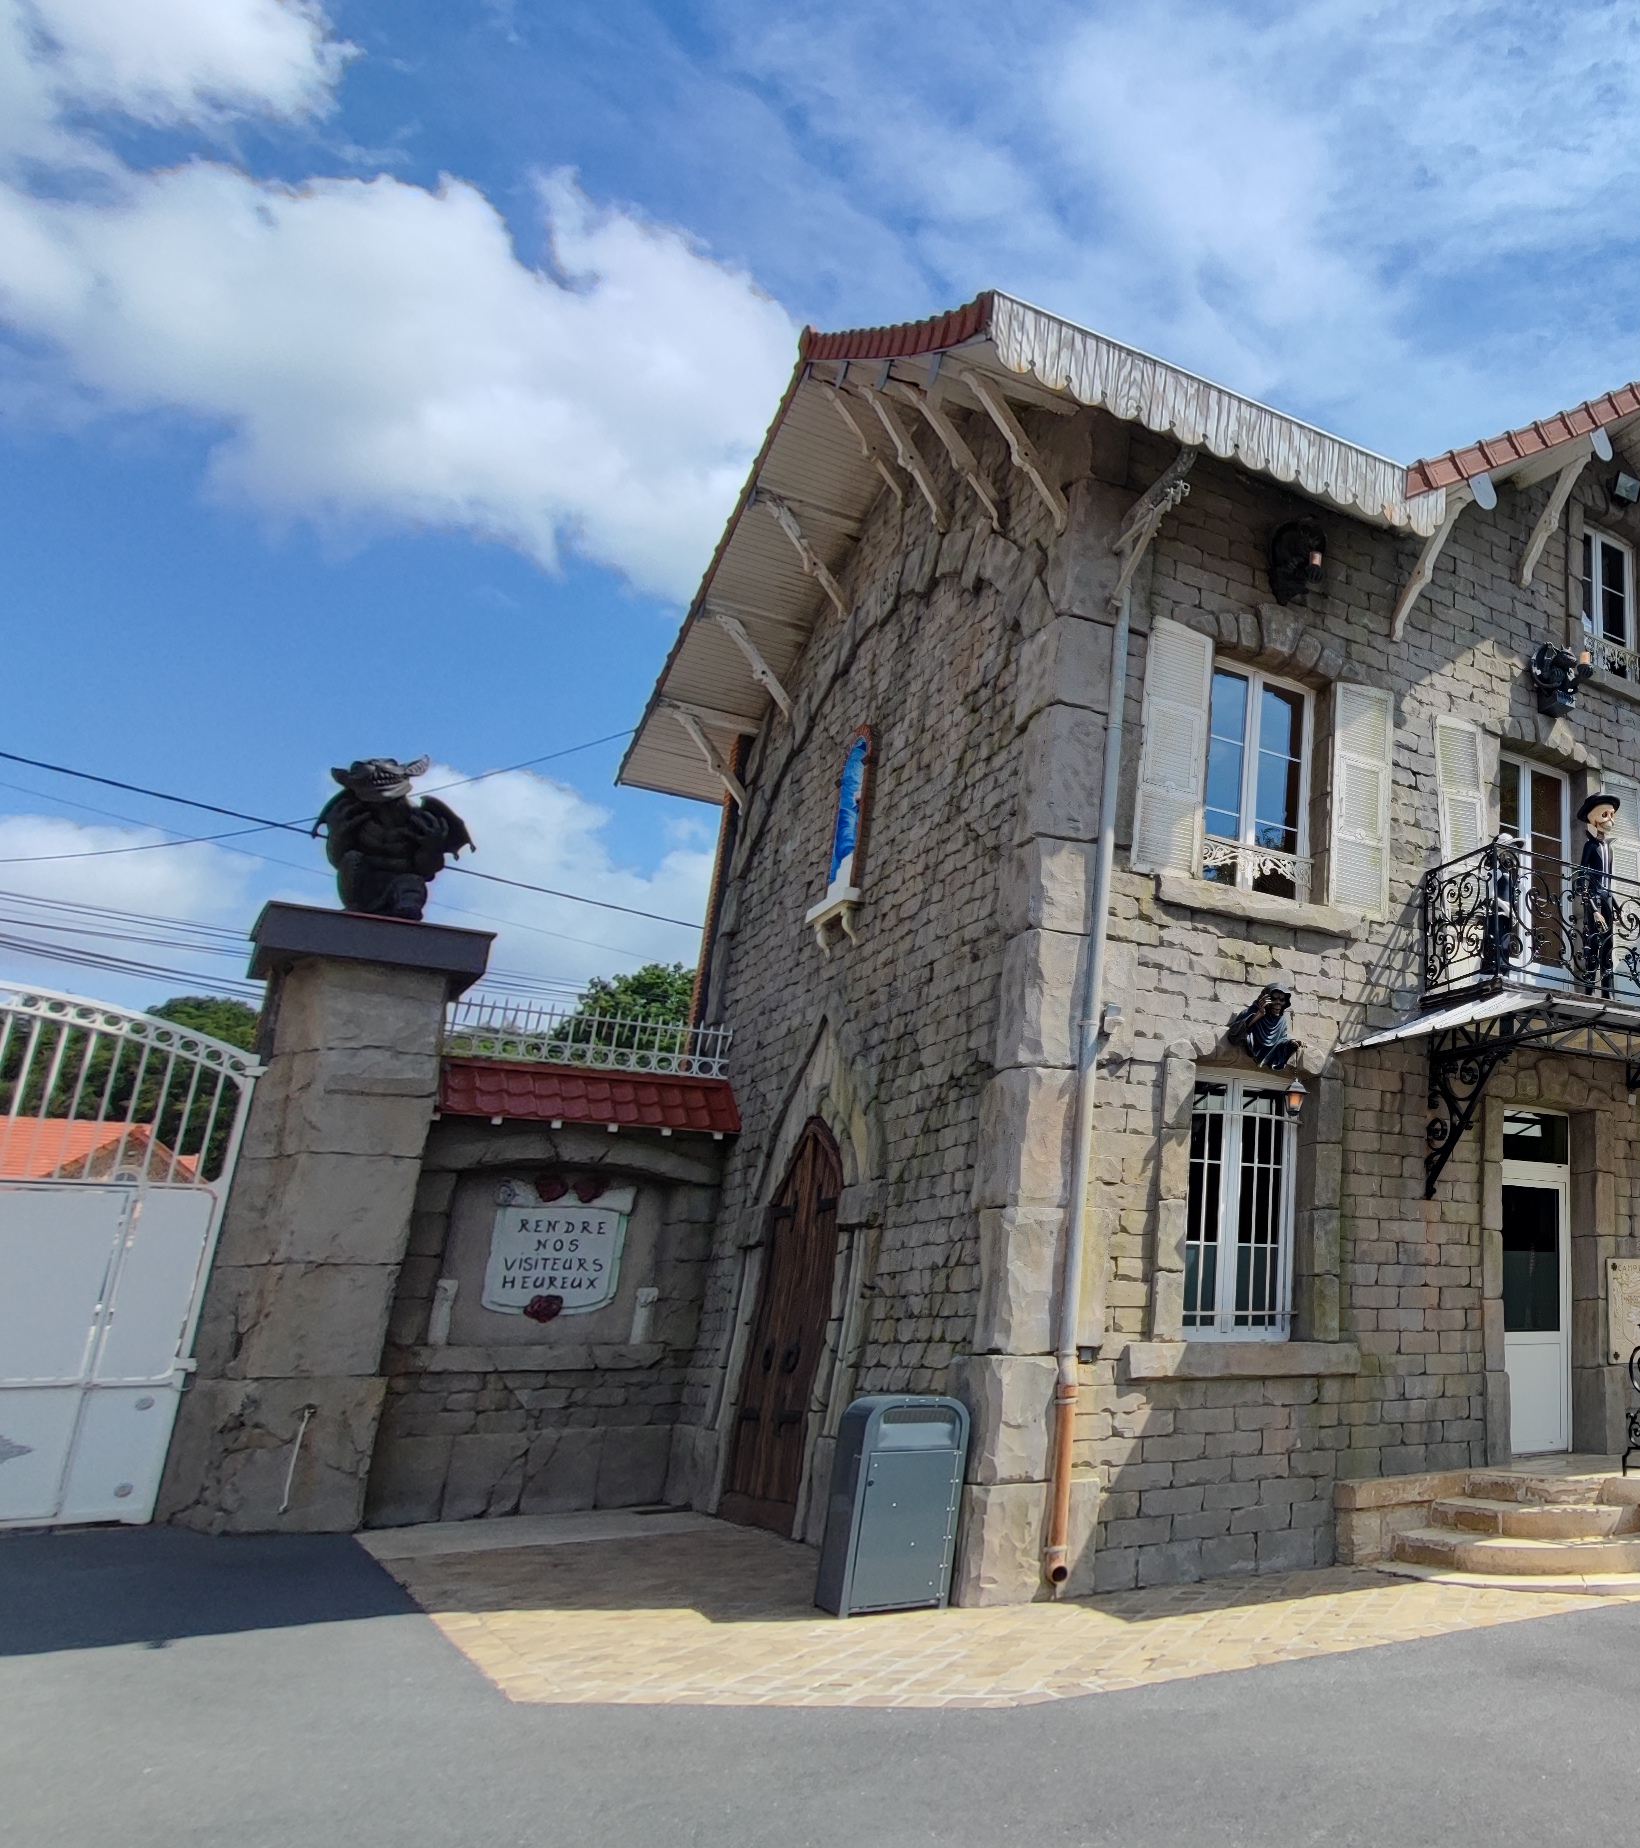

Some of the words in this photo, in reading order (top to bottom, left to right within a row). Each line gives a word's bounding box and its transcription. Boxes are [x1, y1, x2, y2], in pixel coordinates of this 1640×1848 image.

[517, 1218, 607, 1235] RENDRE
[534, 1238, 580, 1252] NOS
[504, 1256, 603, 1272] VISITEURS
[502, 1275, 599, 1289] HEUREUX
